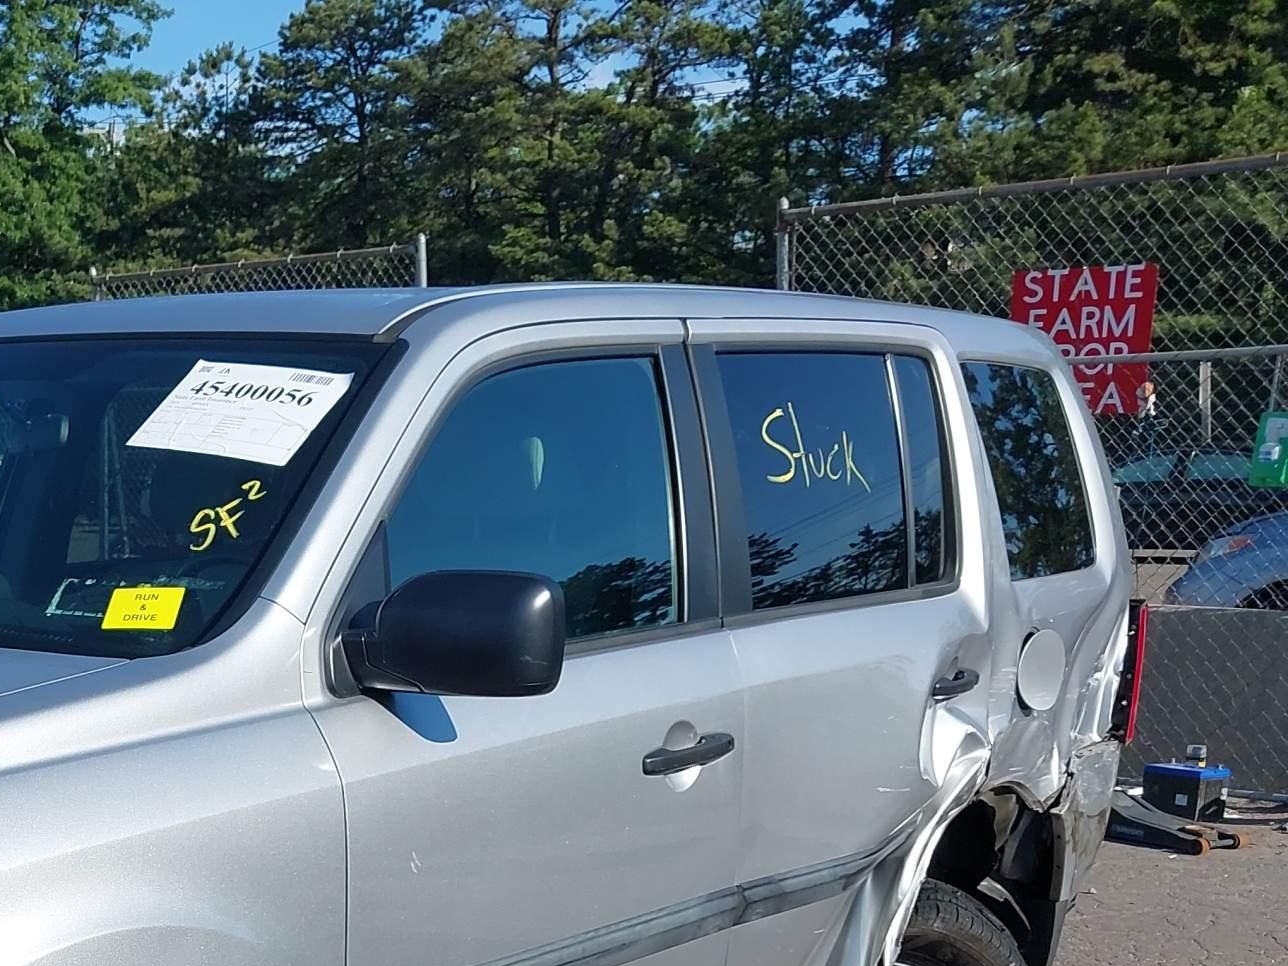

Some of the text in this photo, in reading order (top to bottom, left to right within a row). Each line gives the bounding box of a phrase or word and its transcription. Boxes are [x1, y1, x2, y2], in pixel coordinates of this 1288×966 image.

[1022, 261, 1146, 304] STATE
[1028, 304, 1137, 339] FARM
[190, 379, 320, 408] 45400056
[760, 401, 872, 493] Stuck
[134, 593, 160, 601] RUN
[122, 613, 158, 622] DRIVE
